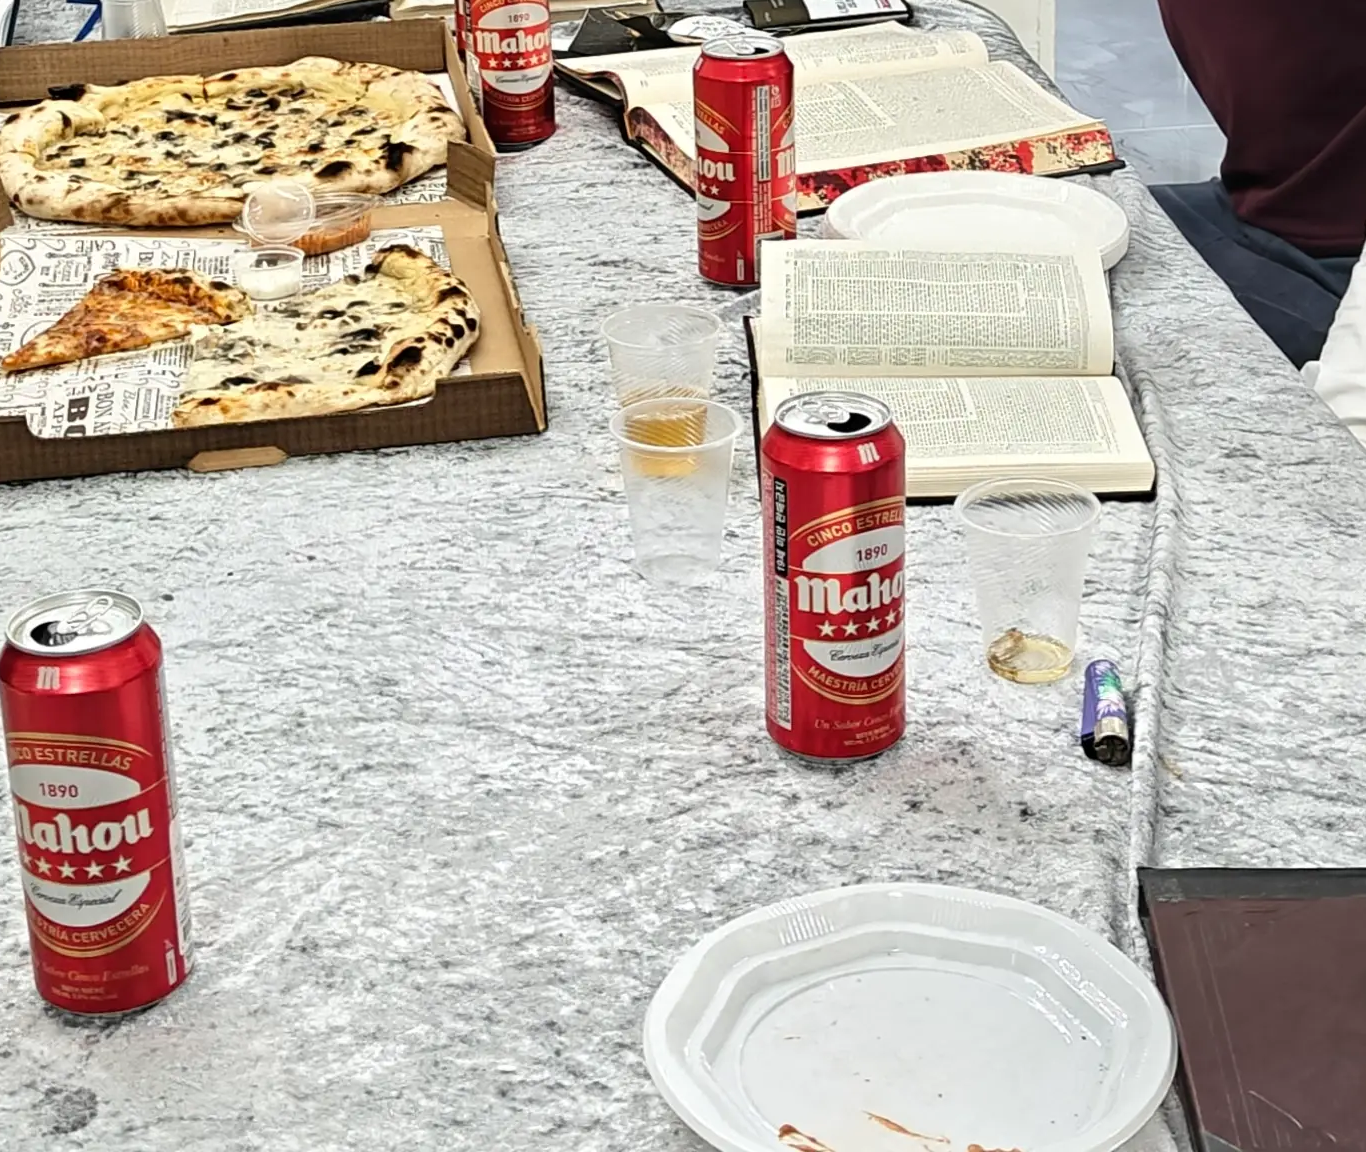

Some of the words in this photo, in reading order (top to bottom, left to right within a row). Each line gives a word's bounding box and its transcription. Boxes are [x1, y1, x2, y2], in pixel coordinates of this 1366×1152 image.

[507, 12, 531, 23] 1890
[75, 239, 116, 253] CAFE
[806, 522, 853, 548] CINCO
[856, 543, 889, 563] 1890
[807, 665, 869, 693] MAESTRÍA
[34, 747, 133, 772] ESTRELLAS
[38, 782, 80, 799] 1890
[71, 902, 150, 944] CERVECERA
